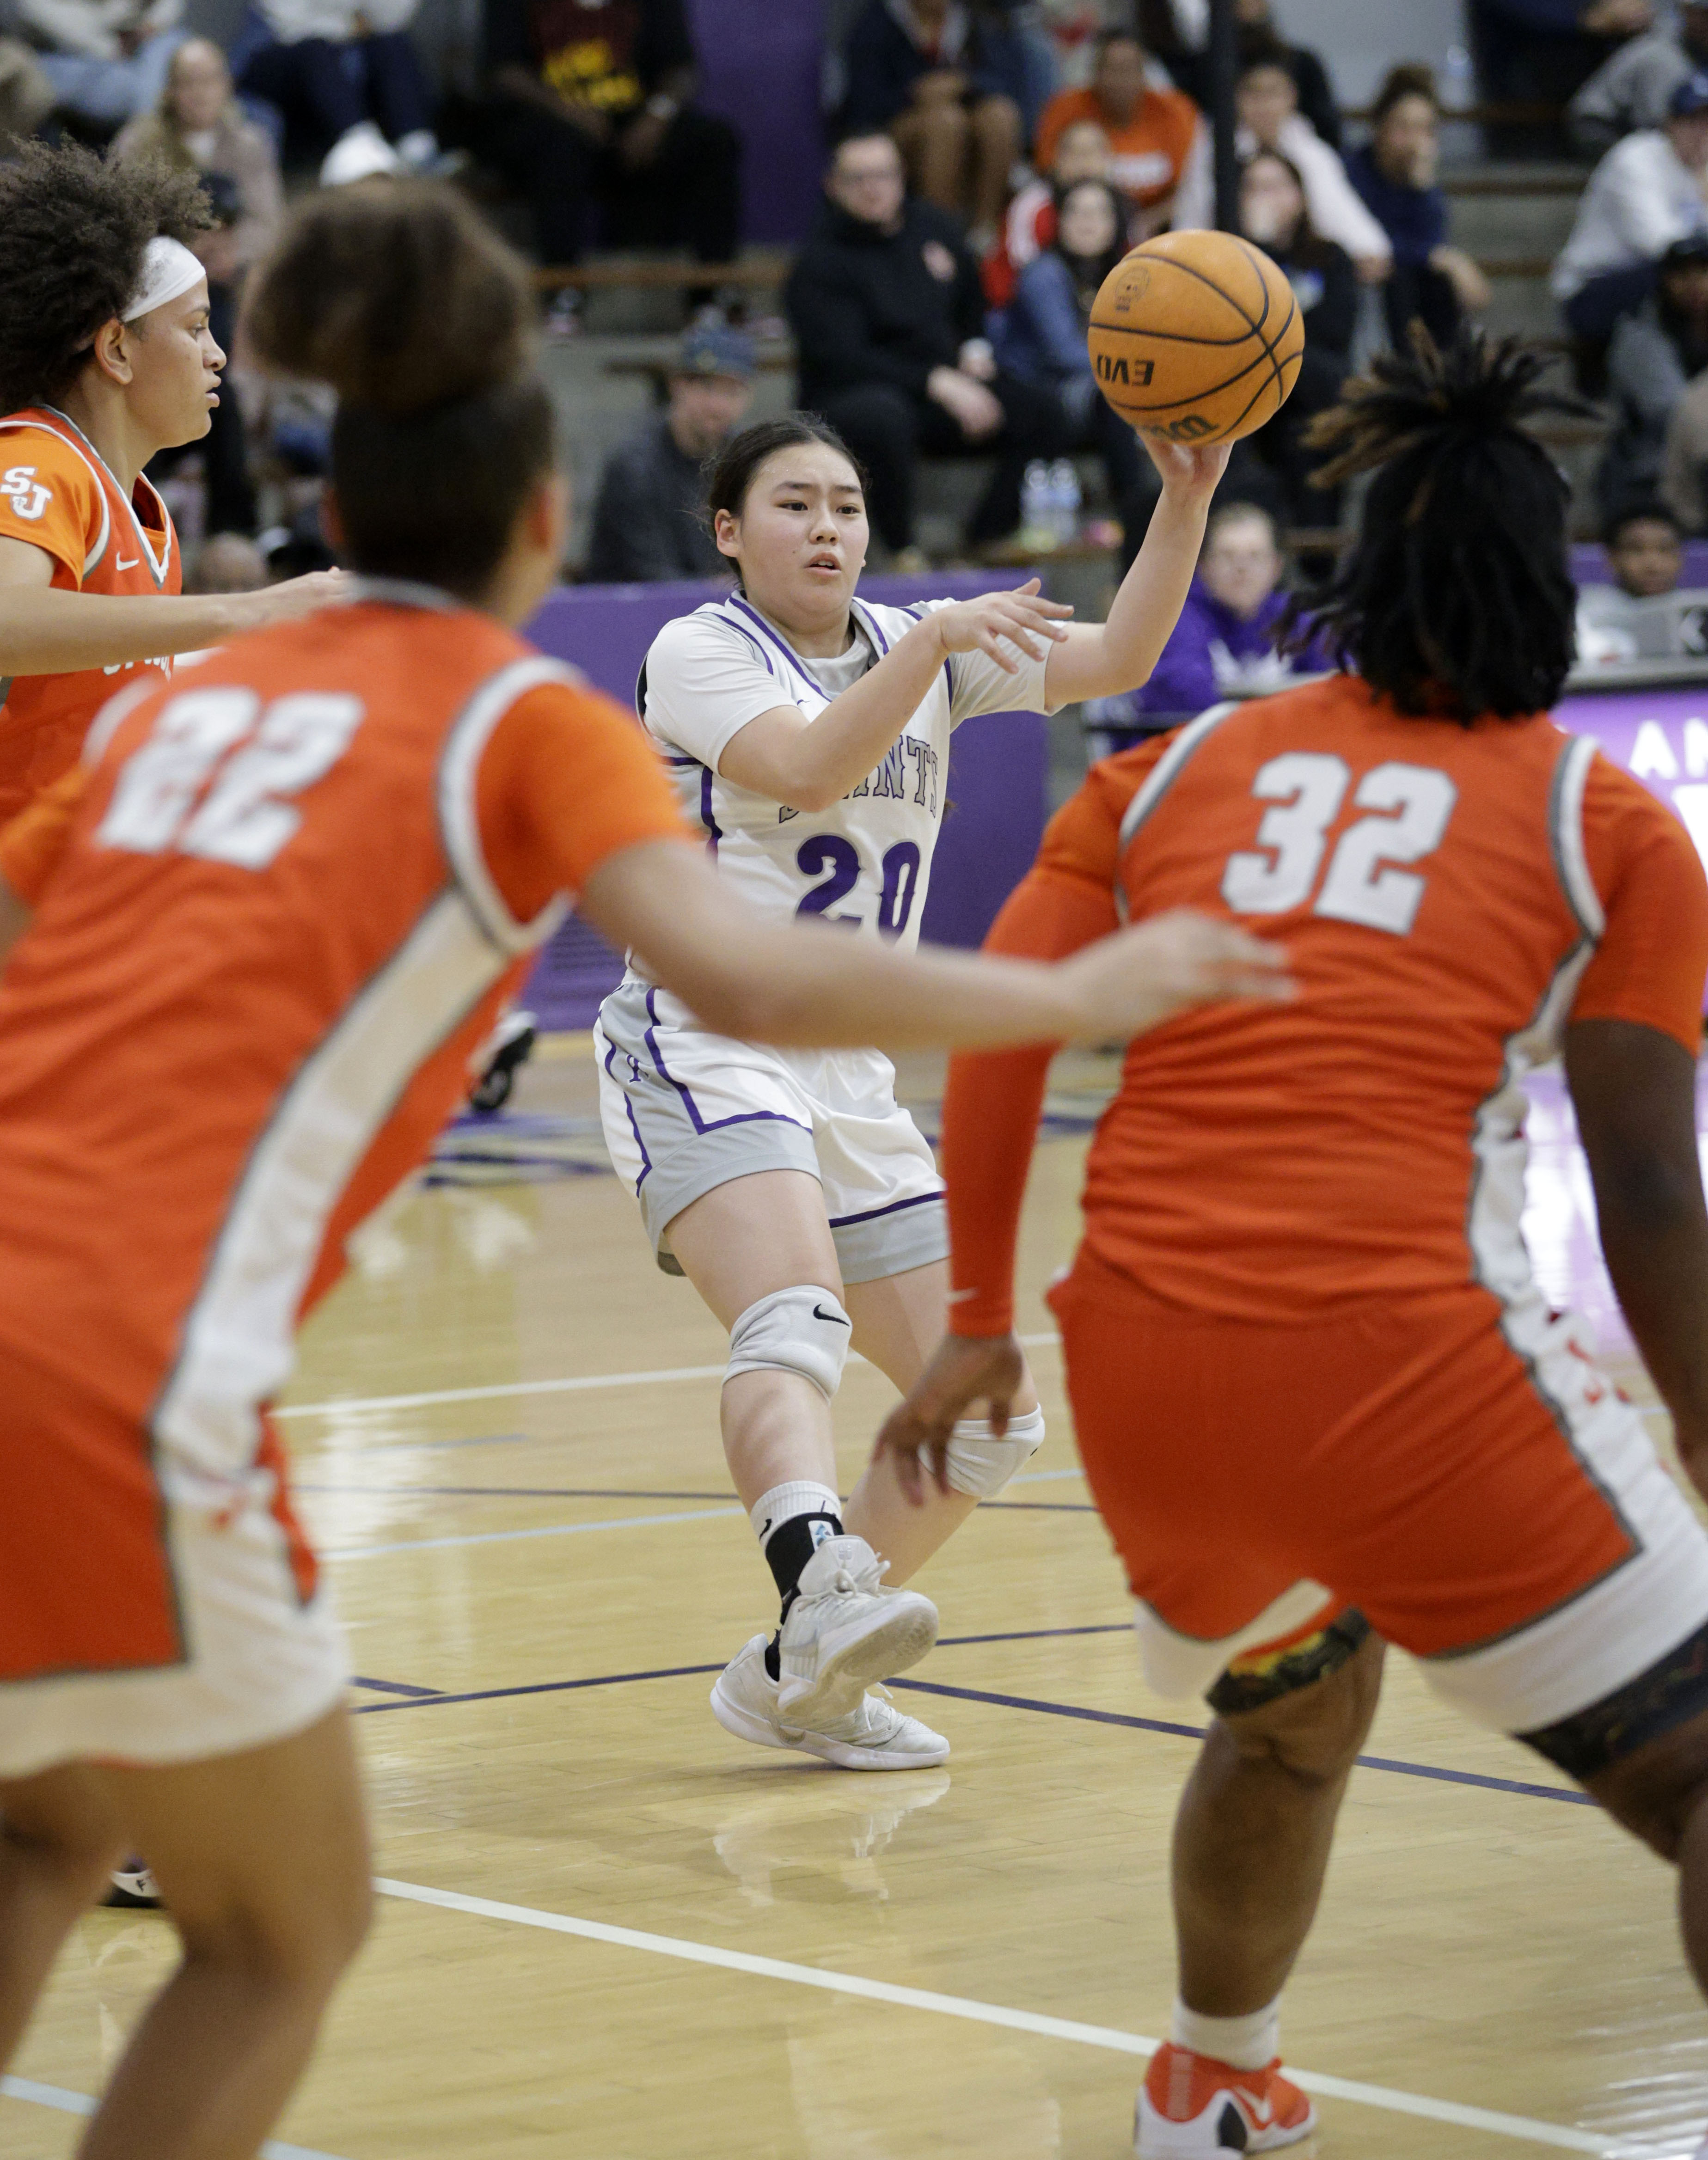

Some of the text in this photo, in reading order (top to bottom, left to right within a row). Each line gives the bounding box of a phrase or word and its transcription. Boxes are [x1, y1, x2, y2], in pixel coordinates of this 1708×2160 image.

[0, 466, 53, 520] SJ
[95, 685, 367, 872] 22
[1219, 750, 1460, 937] 32
[793, 832, 922, 942] 20
